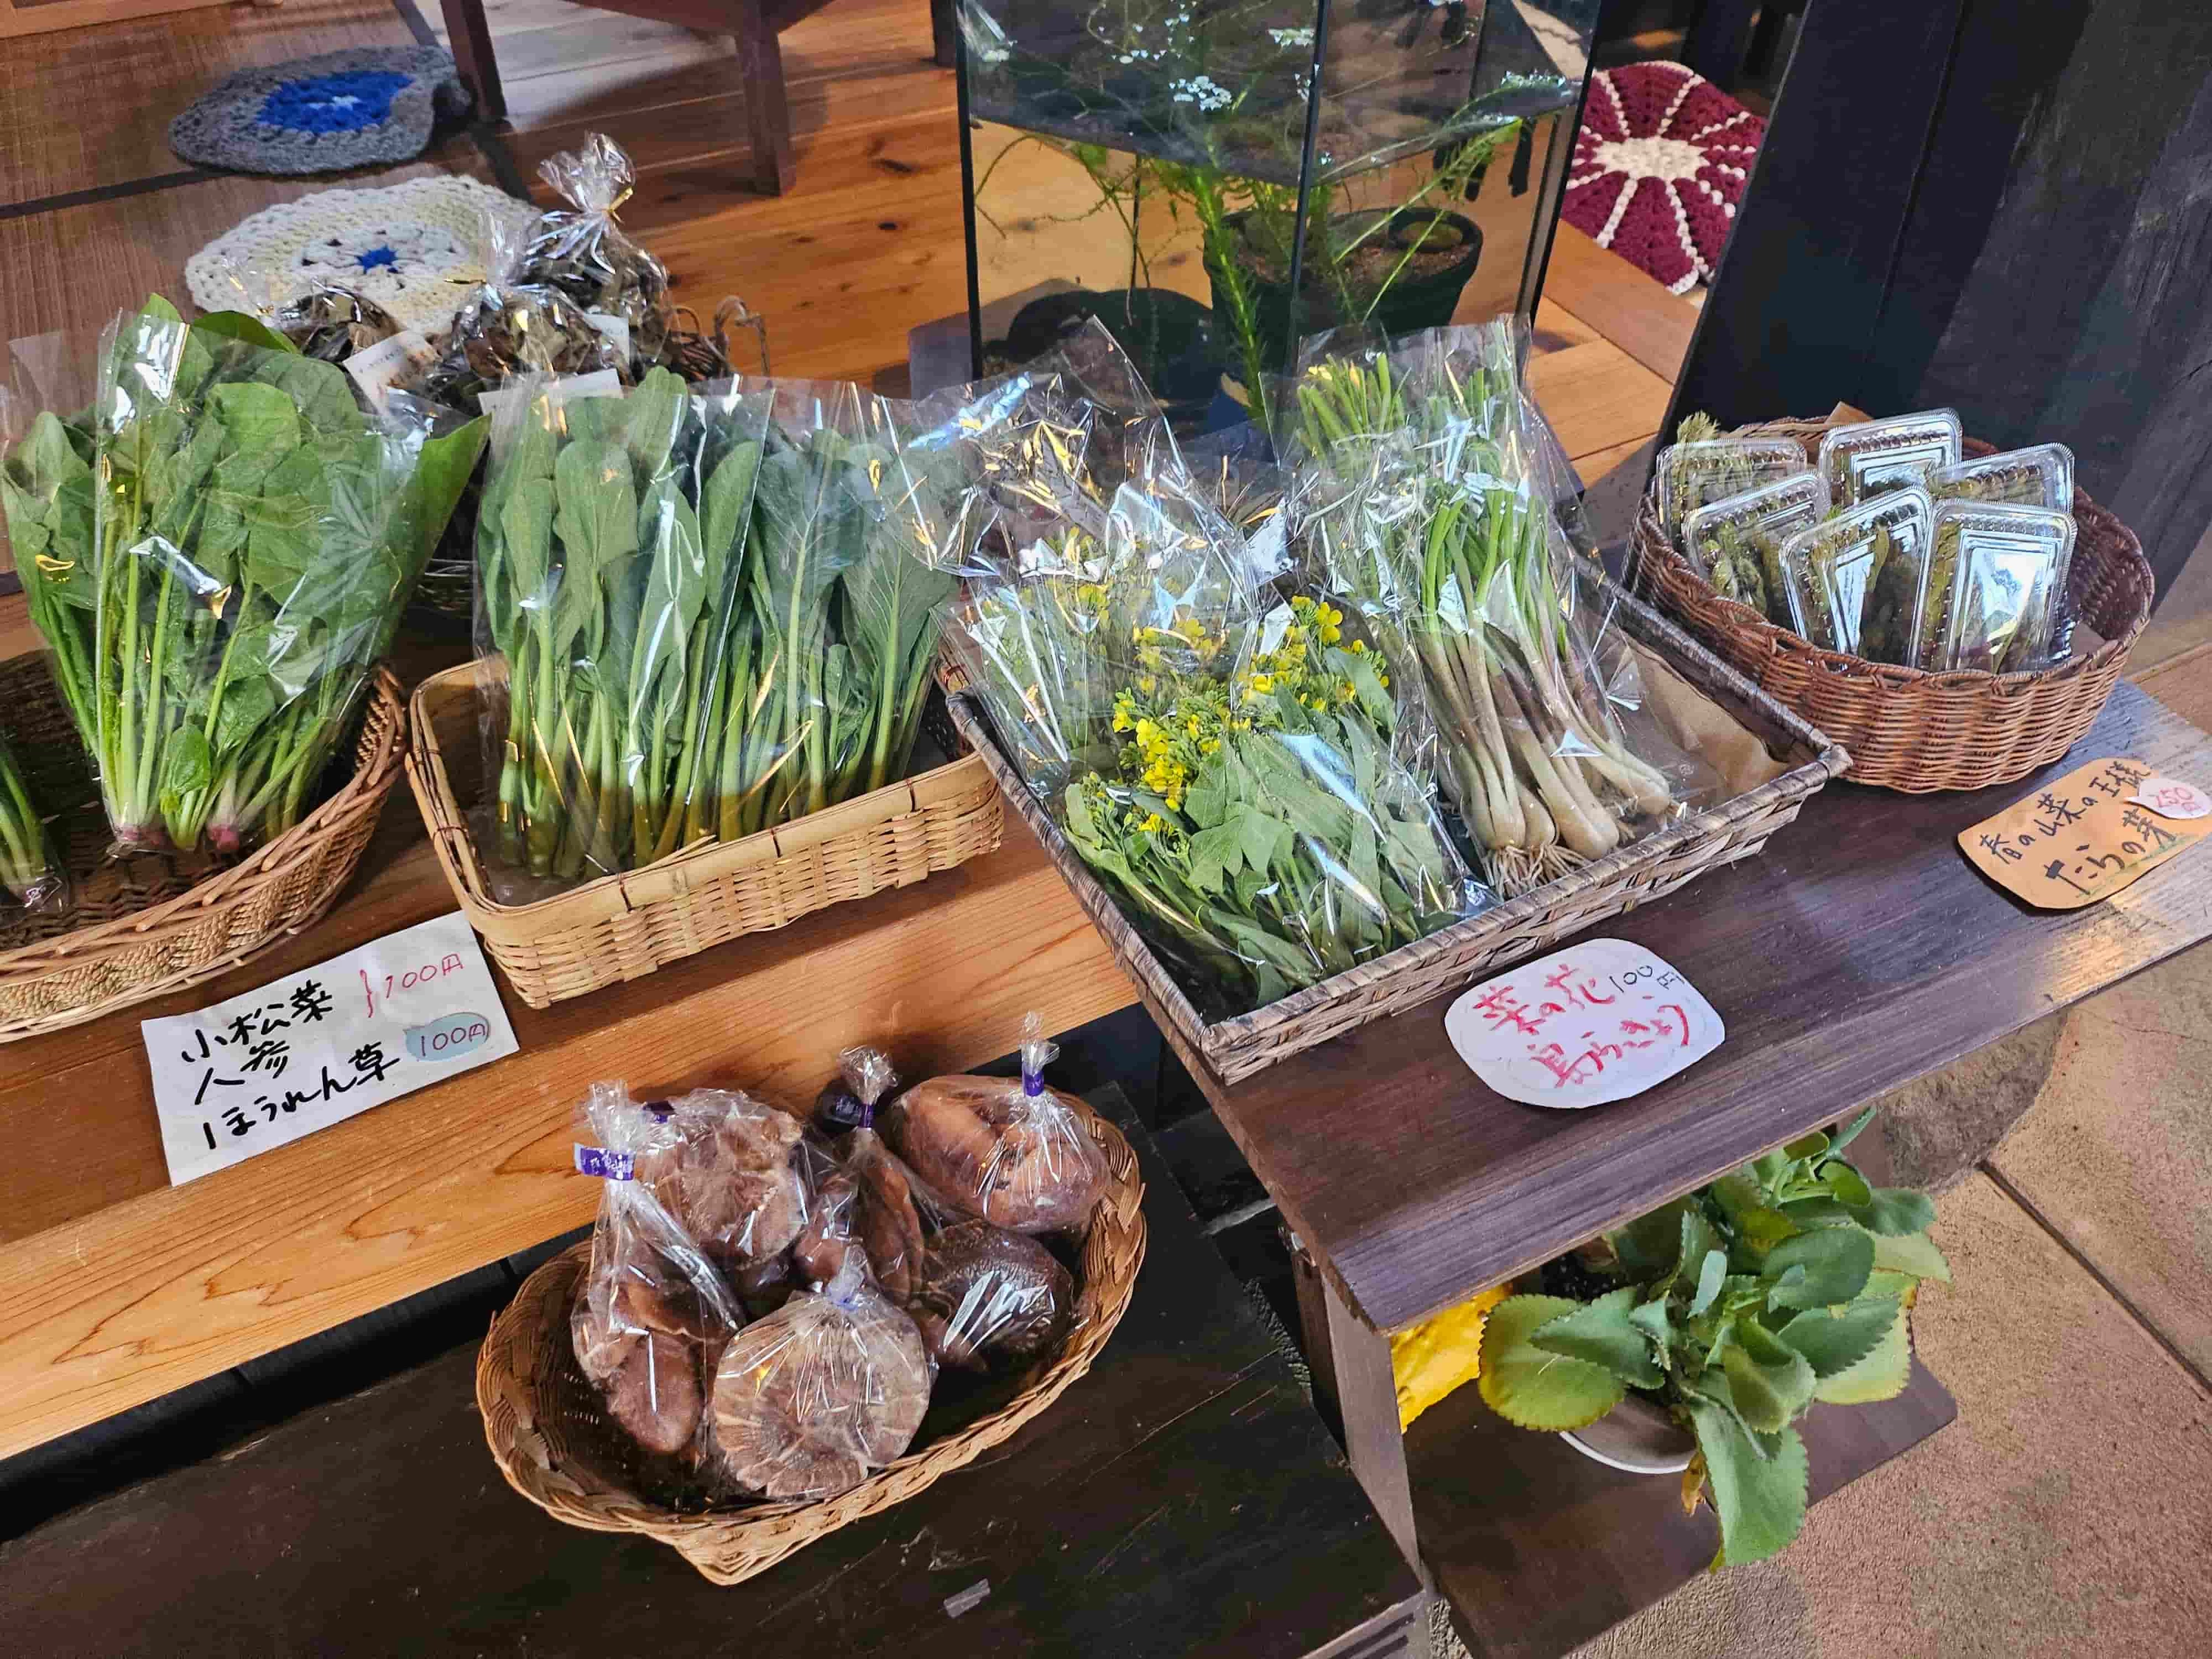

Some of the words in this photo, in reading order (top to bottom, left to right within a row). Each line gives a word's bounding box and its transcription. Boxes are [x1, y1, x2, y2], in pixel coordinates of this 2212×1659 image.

[181, 979, 333, 1062] 小松菜
[1472, 963, 1616, 1035] 菜の花
[420, 1022, 487, 1057] 100円
[203, 1041, 400, 1150] ほうれん草
